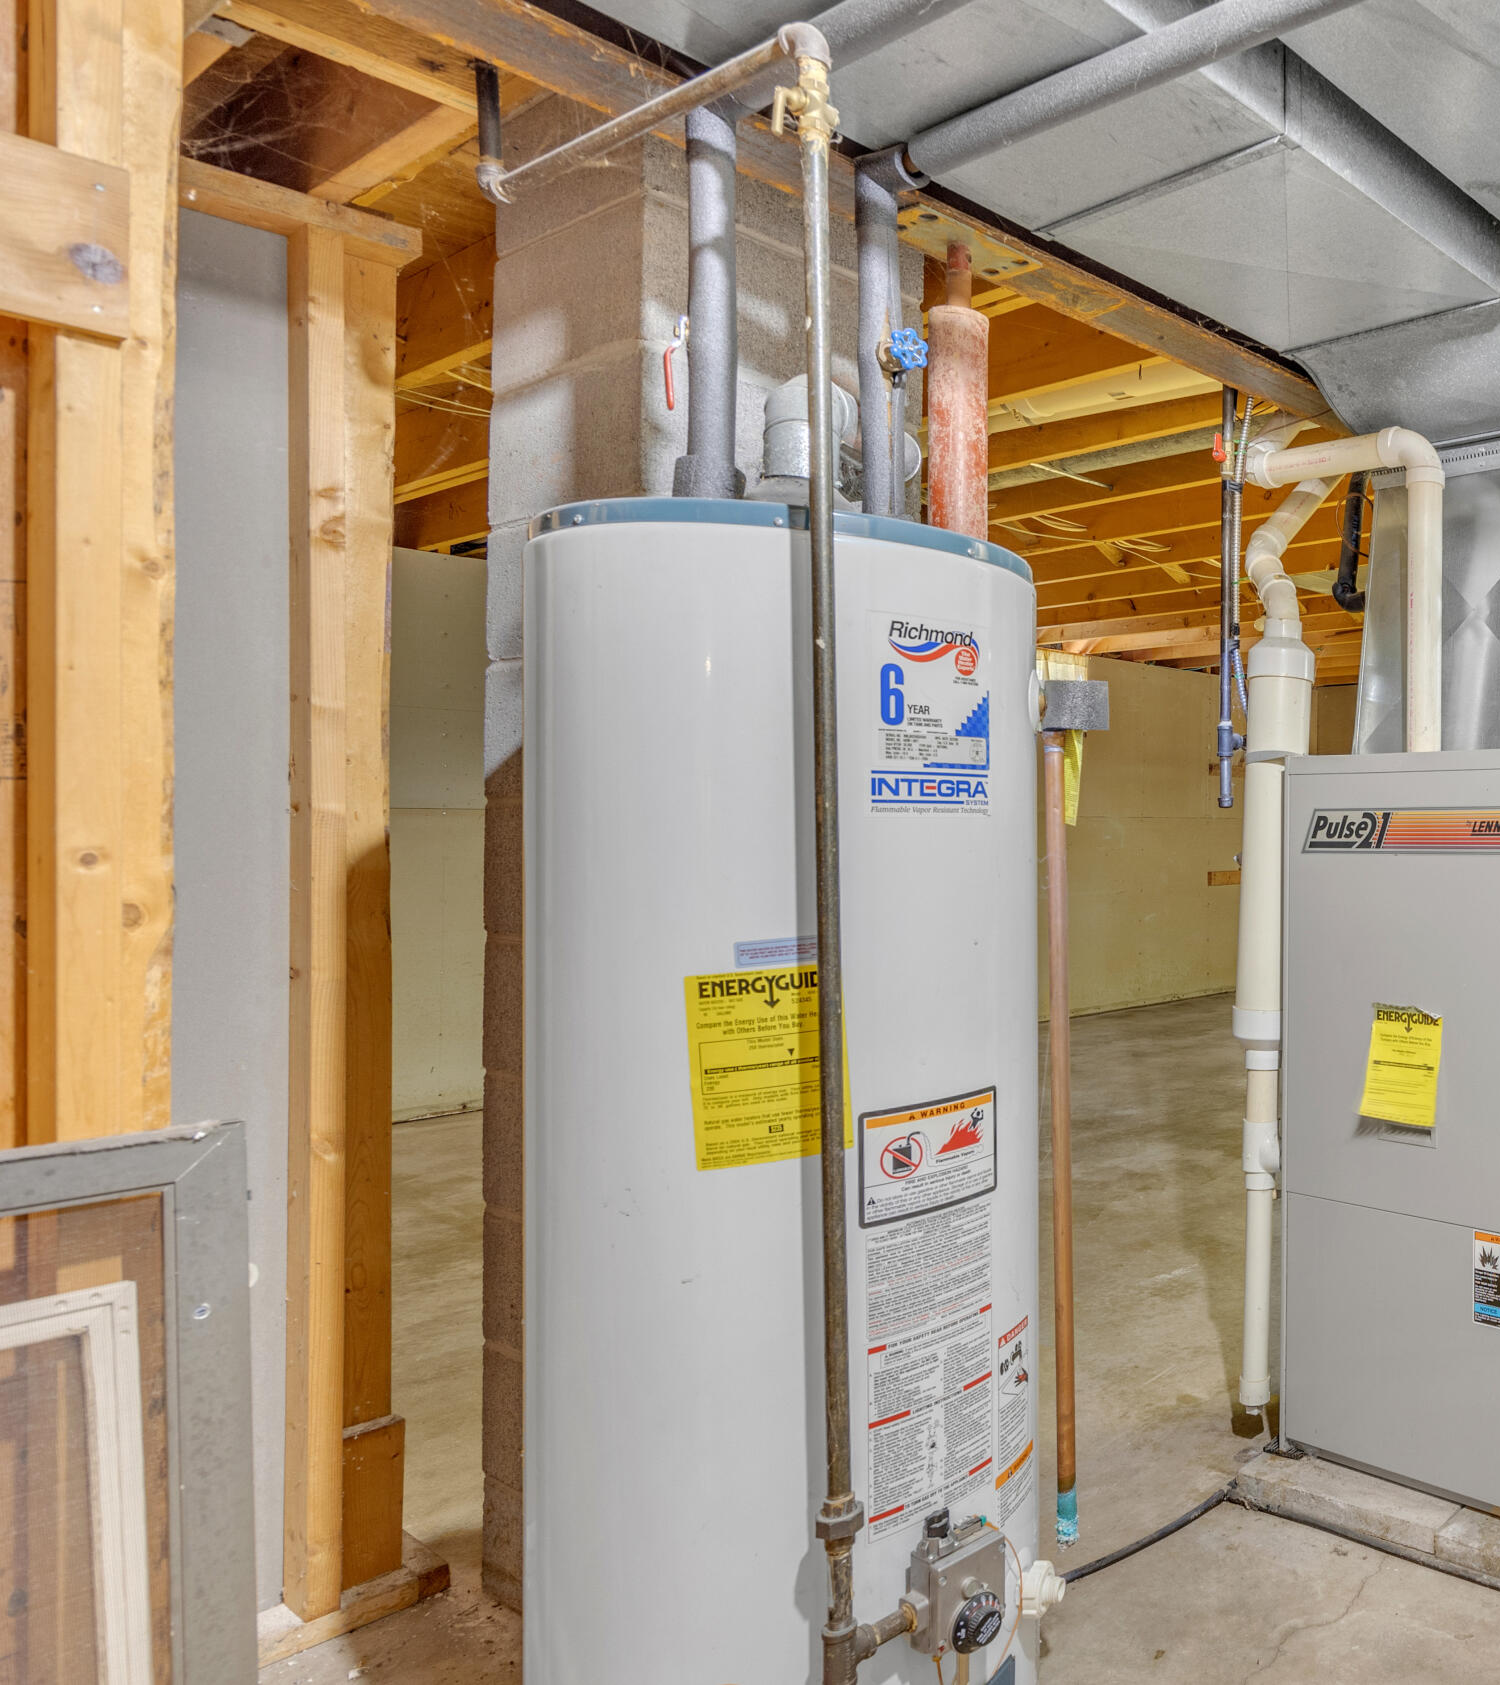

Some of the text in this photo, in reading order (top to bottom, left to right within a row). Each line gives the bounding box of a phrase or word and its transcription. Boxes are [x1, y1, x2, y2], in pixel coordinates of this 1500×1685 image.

[888, 620, 973, 647] Richmond
[880, 663, 904, 725] 6
[907, 704, 930, 715] YEAR
[871, 778, 988, 798] INTEGRA
[912, 807, 932, 815] Vapor
[960, 807, 988, 815] Technology
[1312, 815, 1368, 838] Pulse
[698, 971, 818, 1000] ENERGYGUID
[696, 1022, 722, 1030] Compare
[734, 1018, 754, 1026] Energy
[920, 1102, 965, 1118] WARNING
[913, 1332, 930, 1340] SAFETY
[1006, 1318, 1028, 1340] DANGER
